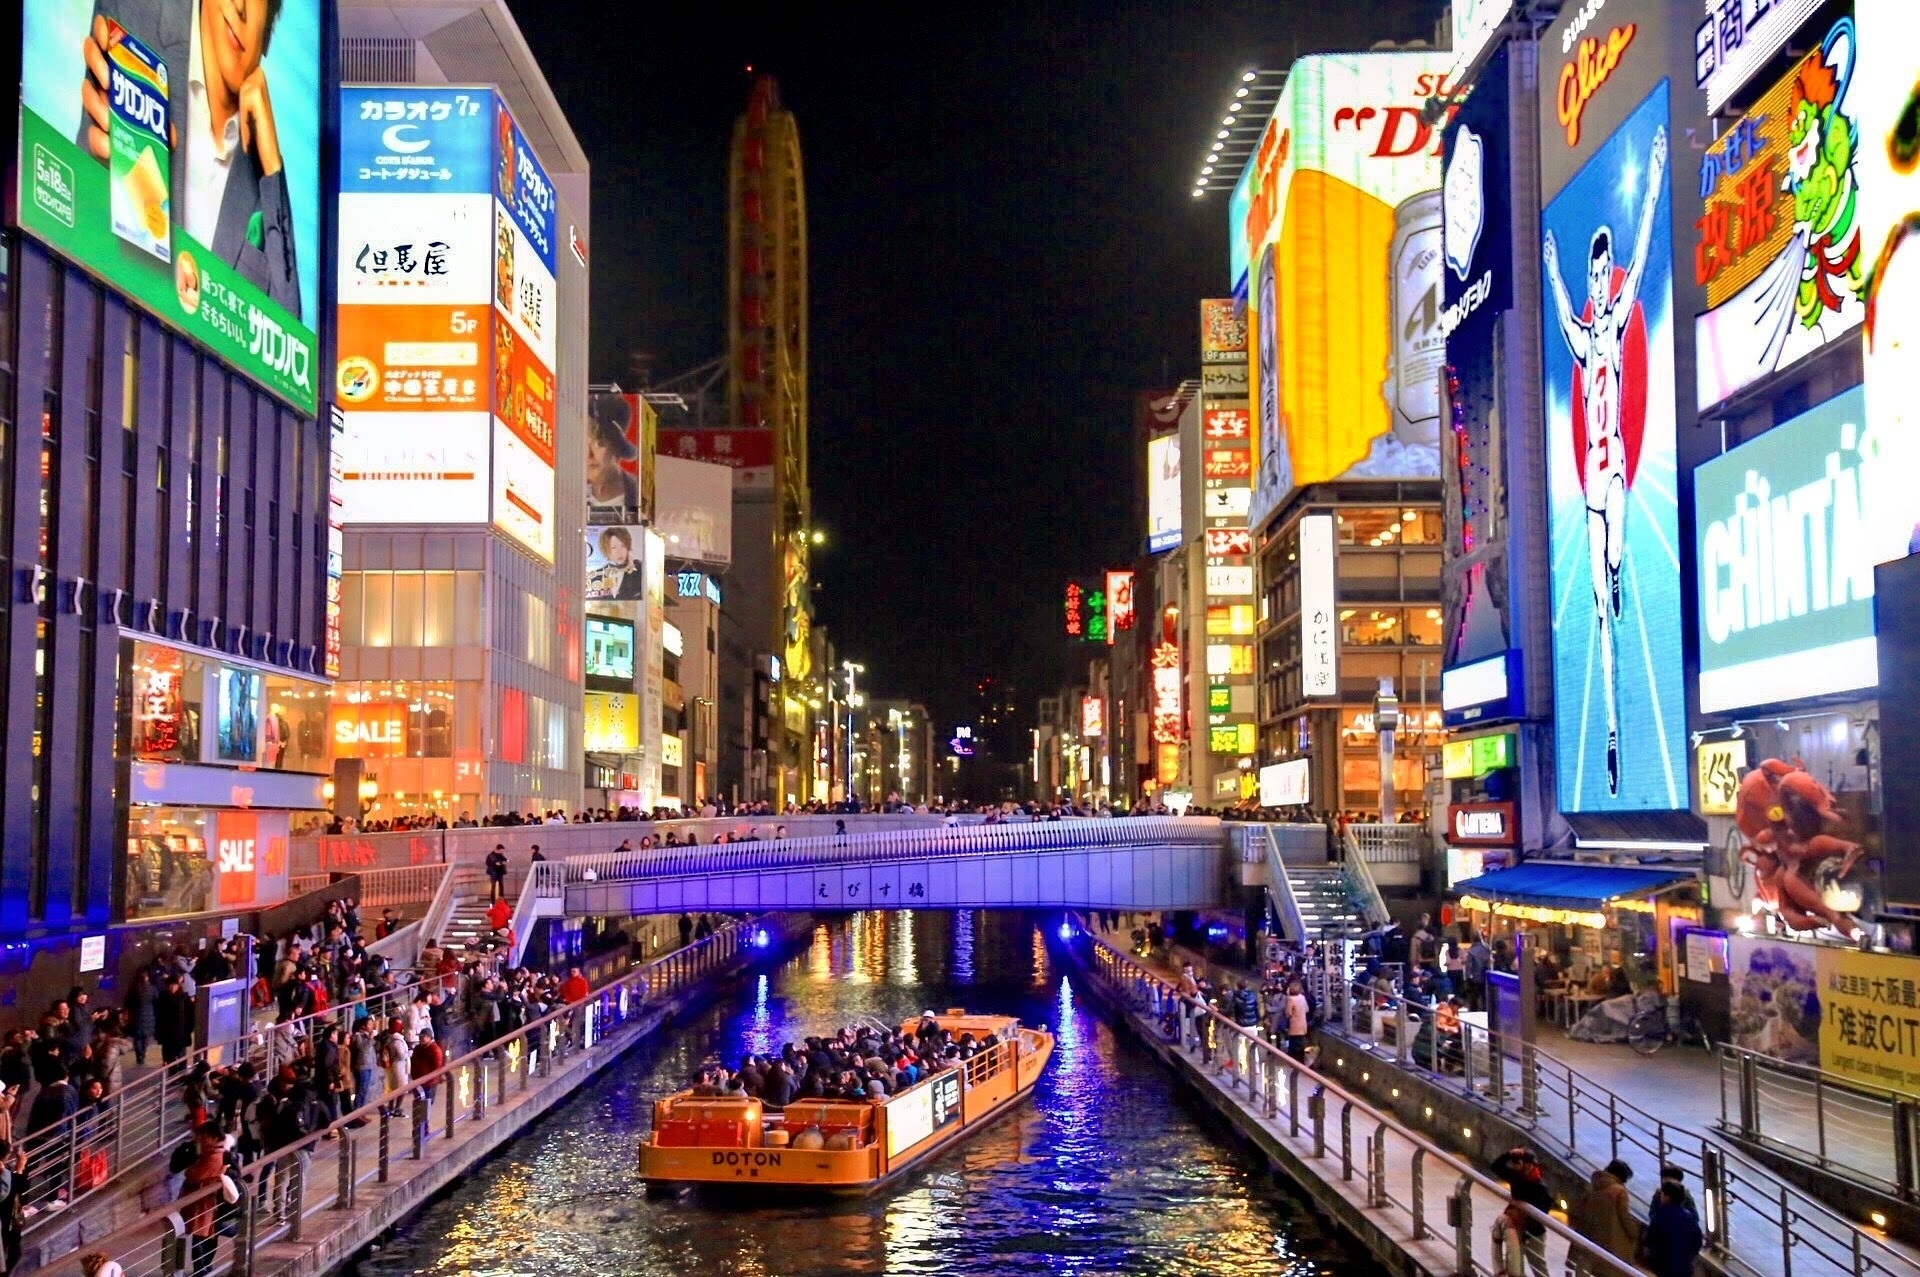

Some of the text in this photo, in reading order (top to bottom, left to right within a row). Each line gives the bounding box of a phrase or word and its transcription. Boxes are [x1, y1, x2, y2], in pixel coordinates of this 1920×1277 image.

[1557, 23, 1637, 147] Glico
[113, 69, 168, 141] サロンパス
[360, 100, 452, 121] カラオケ
[1694, 155, 1775, 286] 改源
[355, 241, 451, 275] 但馬屋
[450, 311, 477, 334] 5F
[248, 303, 312, 394] サロンパス
[335, 720, 403, 744] SALE
[1708, 752, 1737, 803] くくる
[219, 839, 255, 873] SALE
[818, 882, 924, 898] えびす橋
[1829, 972, 1920, 1010] 从这里到大阪最
[712, 1151, 781, 1167] DOTON
